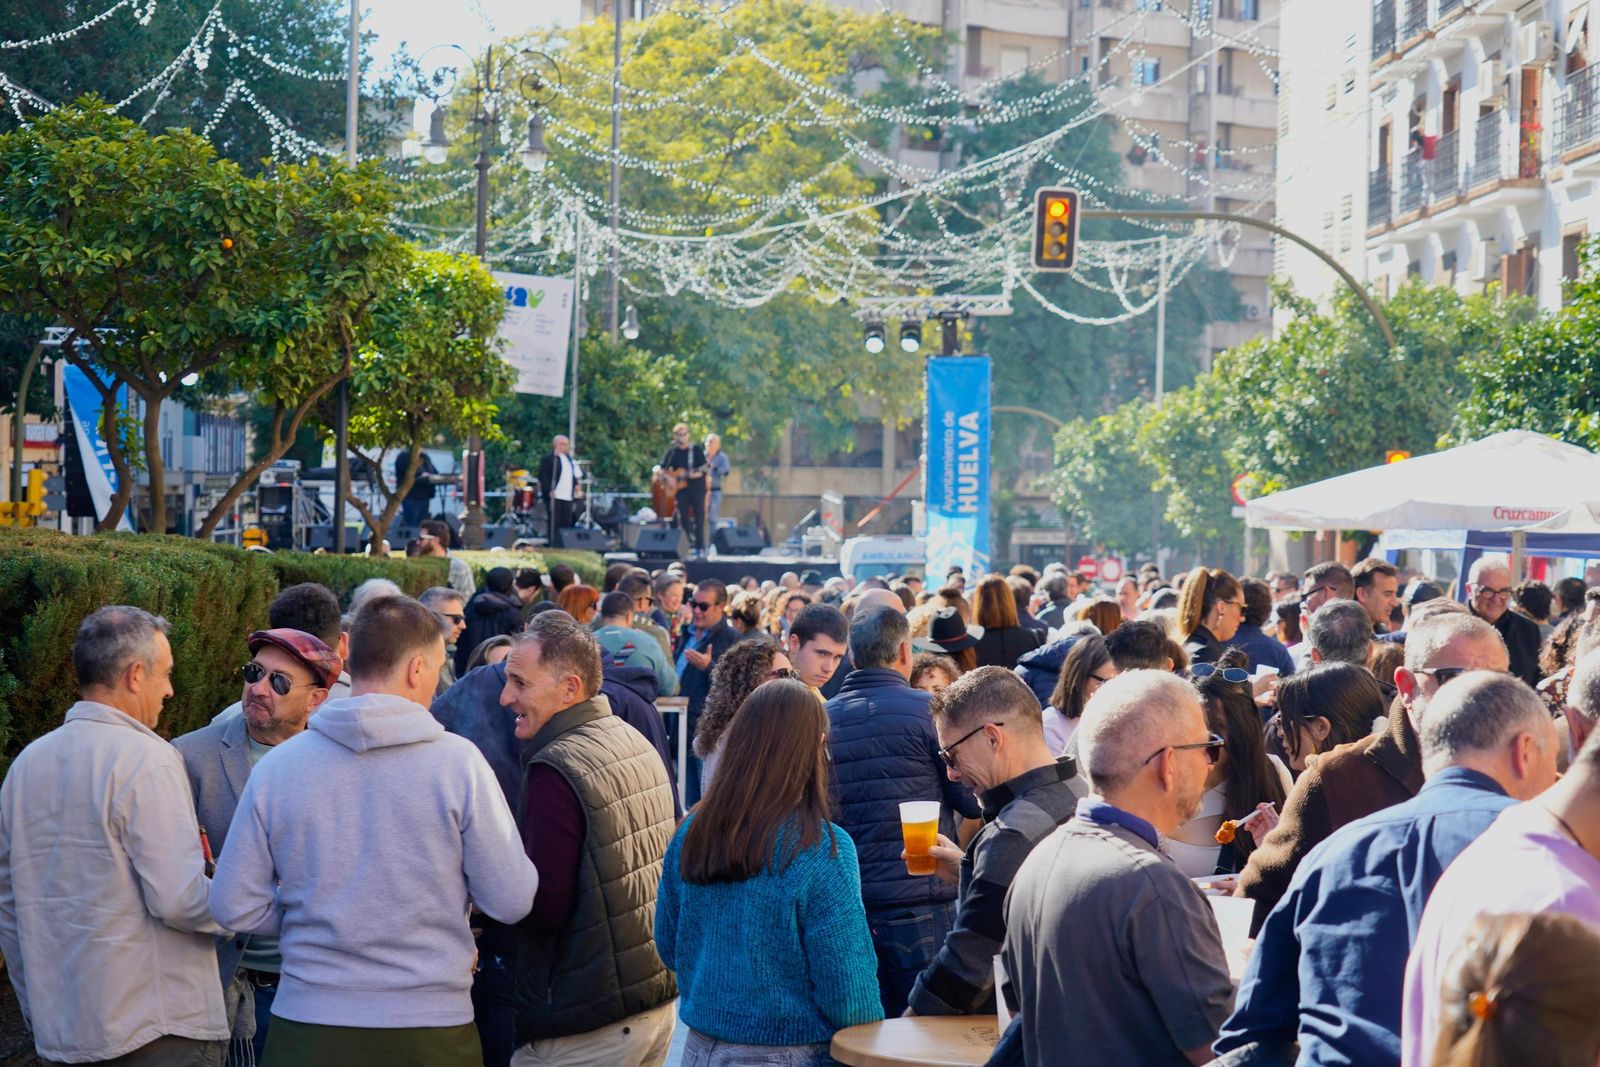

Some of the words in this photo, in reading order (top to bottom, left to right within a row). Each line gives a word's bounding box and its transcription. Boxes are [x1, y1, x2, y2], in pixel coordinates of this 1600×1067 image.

[942, 411, 955, 427] de
[942, 428, 956, 512] Ayuntamiento
[958, 411, 979, 513] HUELVA
